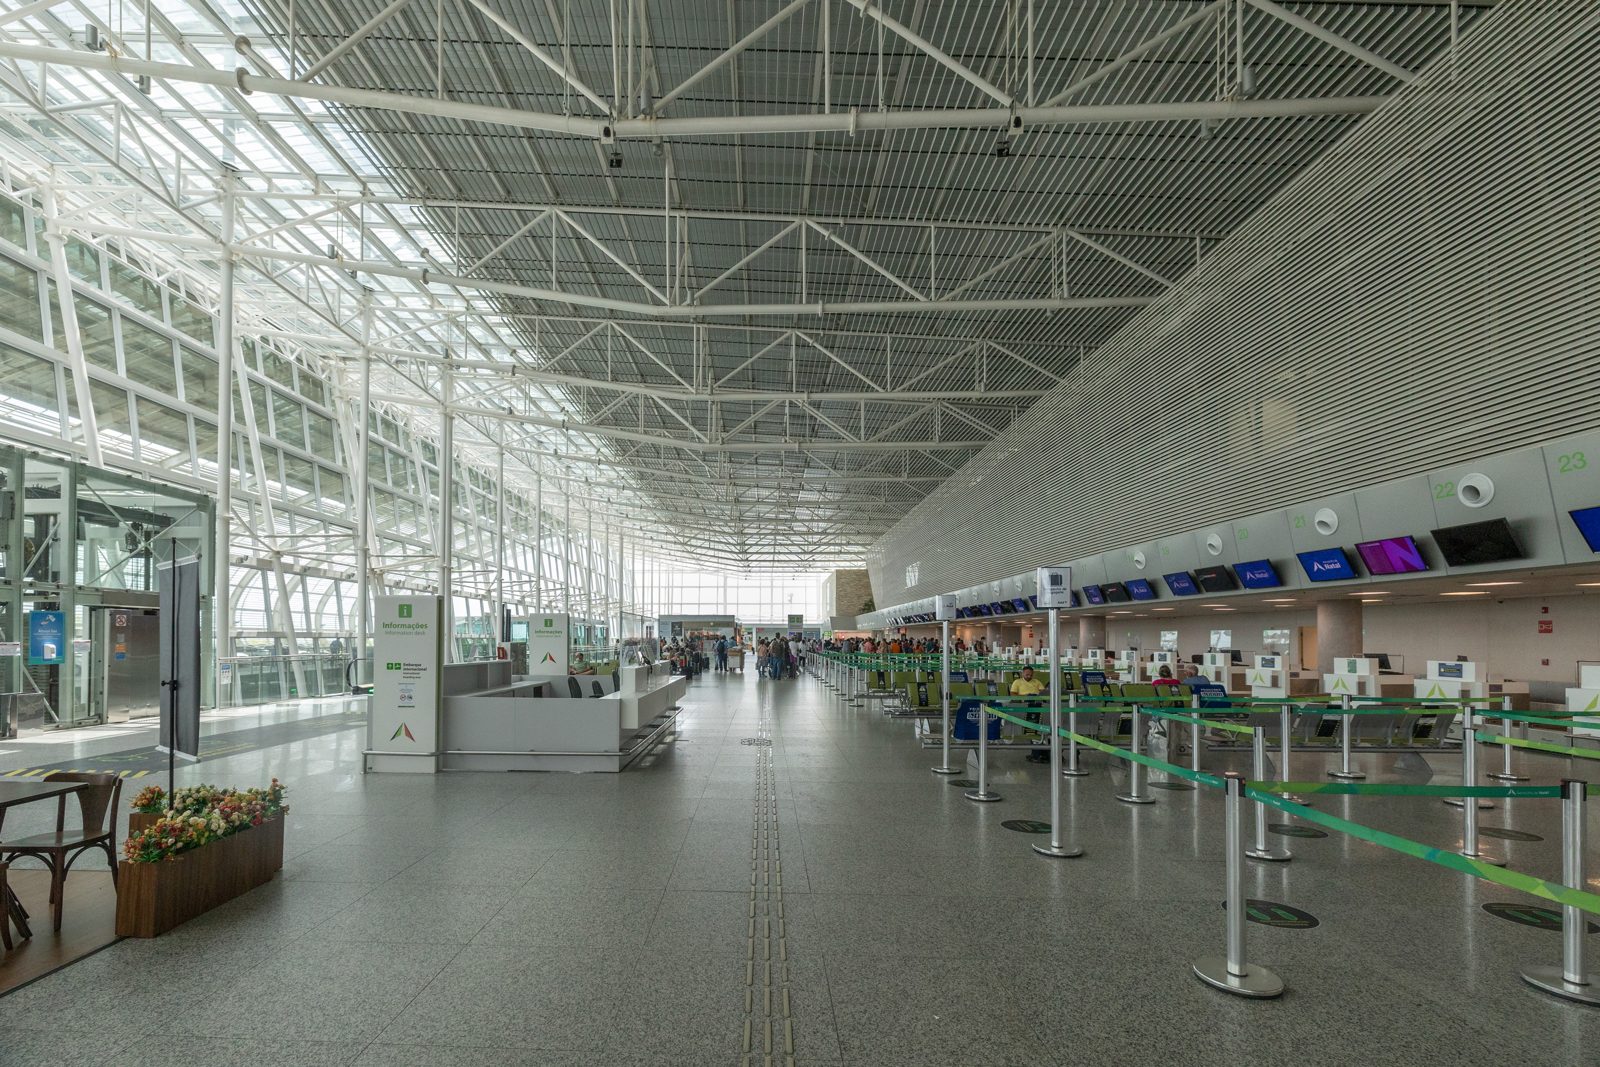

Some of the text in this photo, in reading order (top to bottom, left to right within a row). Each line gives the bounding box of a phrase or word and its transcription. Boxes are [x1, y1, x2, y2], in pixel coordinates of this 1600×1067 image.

[1558, 451, 1588, 473] 23
[1434, 481, 1456, 499] 22
[1294, 515, 1306, 529] 21
[1238, 528, 1249, 540] 20
[1323, 562, 1342, 570] Natal
[382, 622, 428, 630] Informações
